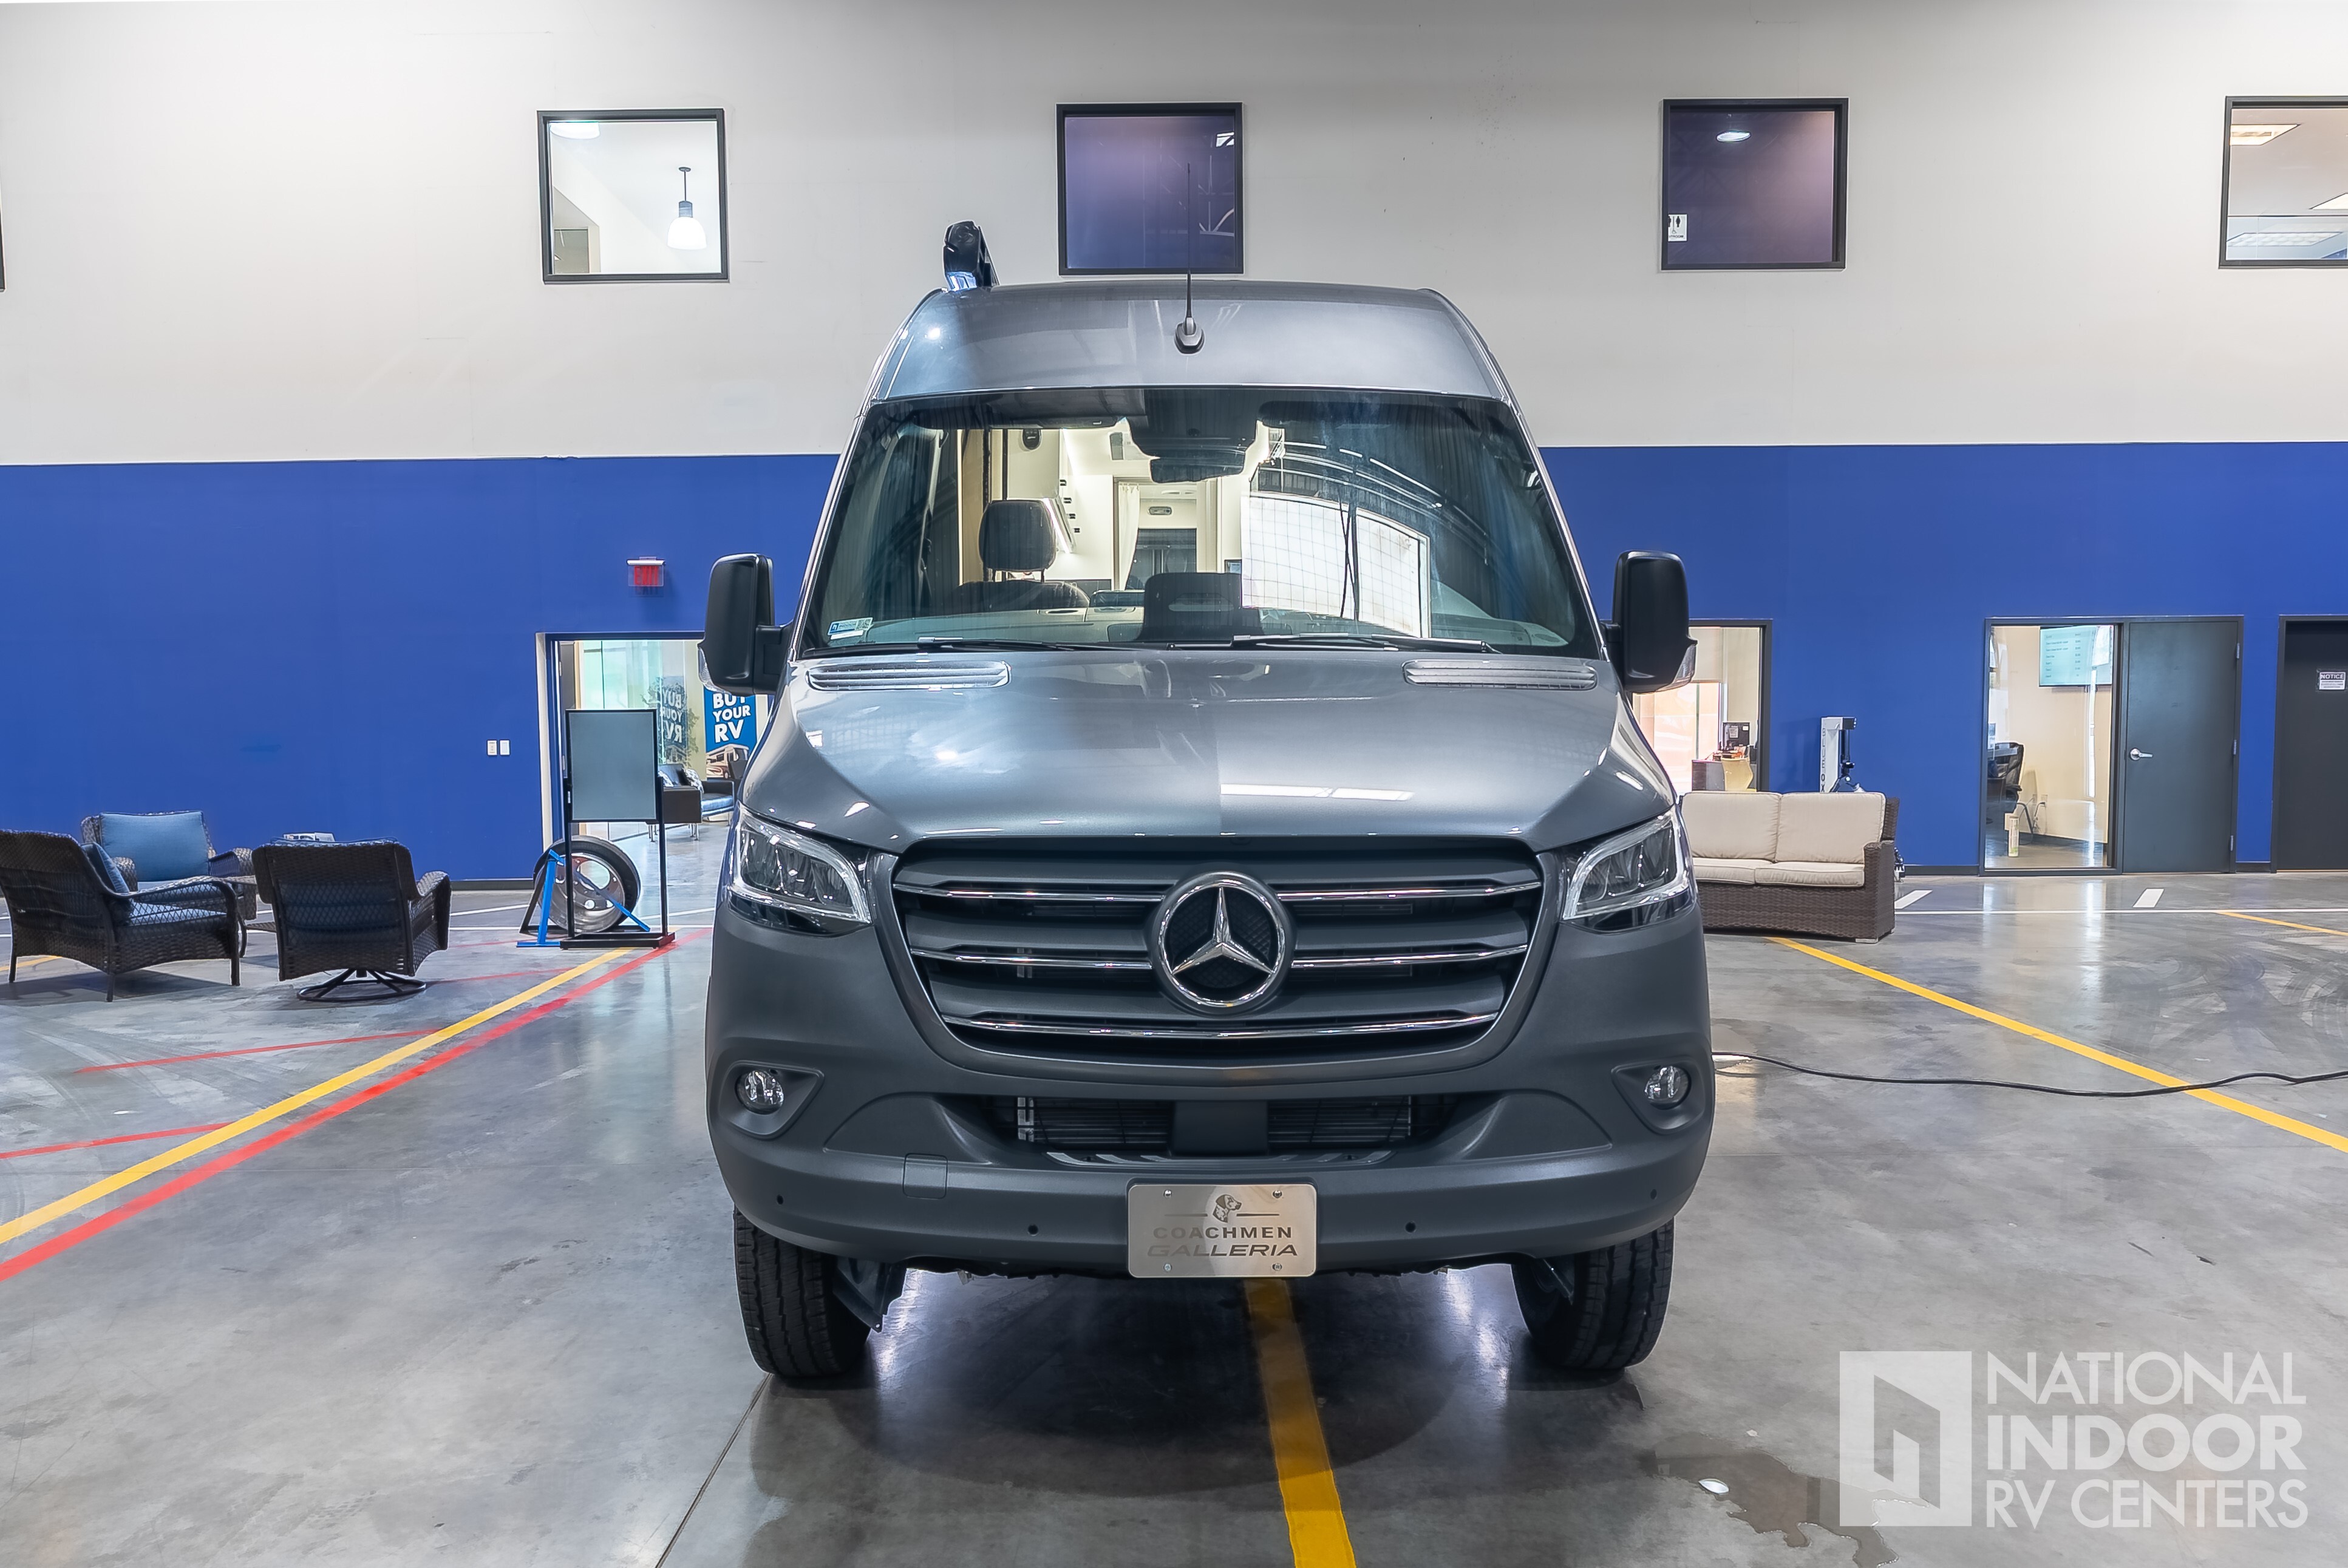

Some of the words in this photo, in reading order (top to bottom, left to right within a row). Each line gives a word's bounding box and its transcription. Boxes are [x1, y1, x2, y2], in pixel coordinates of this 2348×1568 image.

[712, 705, 751, 722] YOUR
[715, 719, 744, 743] RV
[1153, 1227, 1292, 1239] COACHMEN
[1147, 1244, 1298, 1257] GALLERIA
